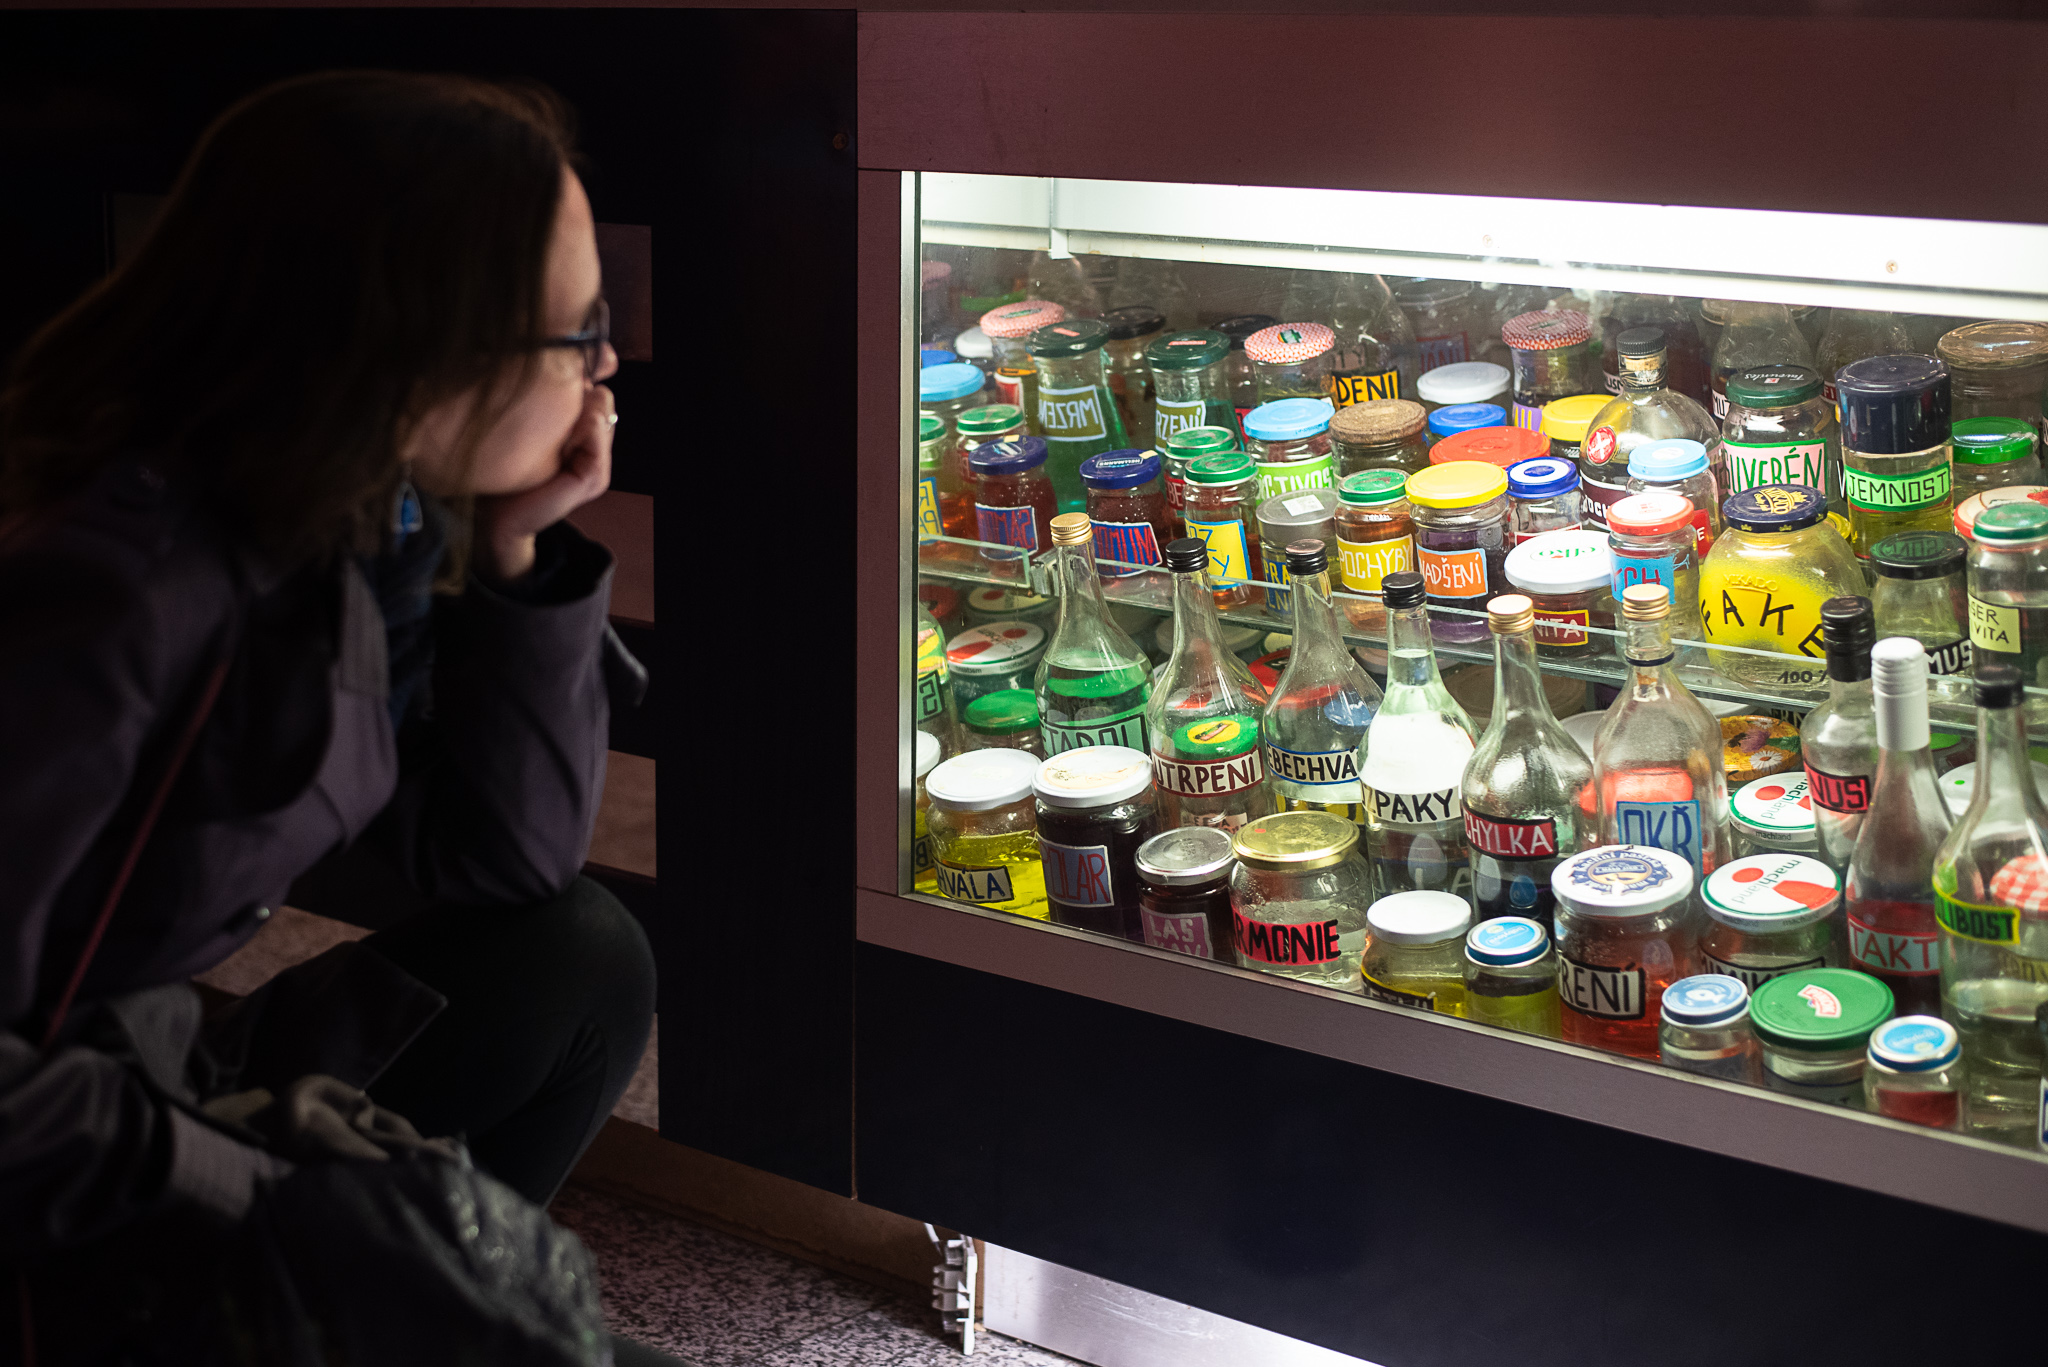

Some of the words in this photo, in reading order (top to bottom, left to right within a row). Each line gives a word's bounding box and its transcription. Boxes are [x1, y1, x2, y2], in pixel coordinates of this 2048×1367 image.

[1849, 470, 1947, 506] JEMNOST
[1755, 830, 1792, 842] machland
[1731, 859, 1802, 904] machland
[1149, 917, 1195, 943] LAS
